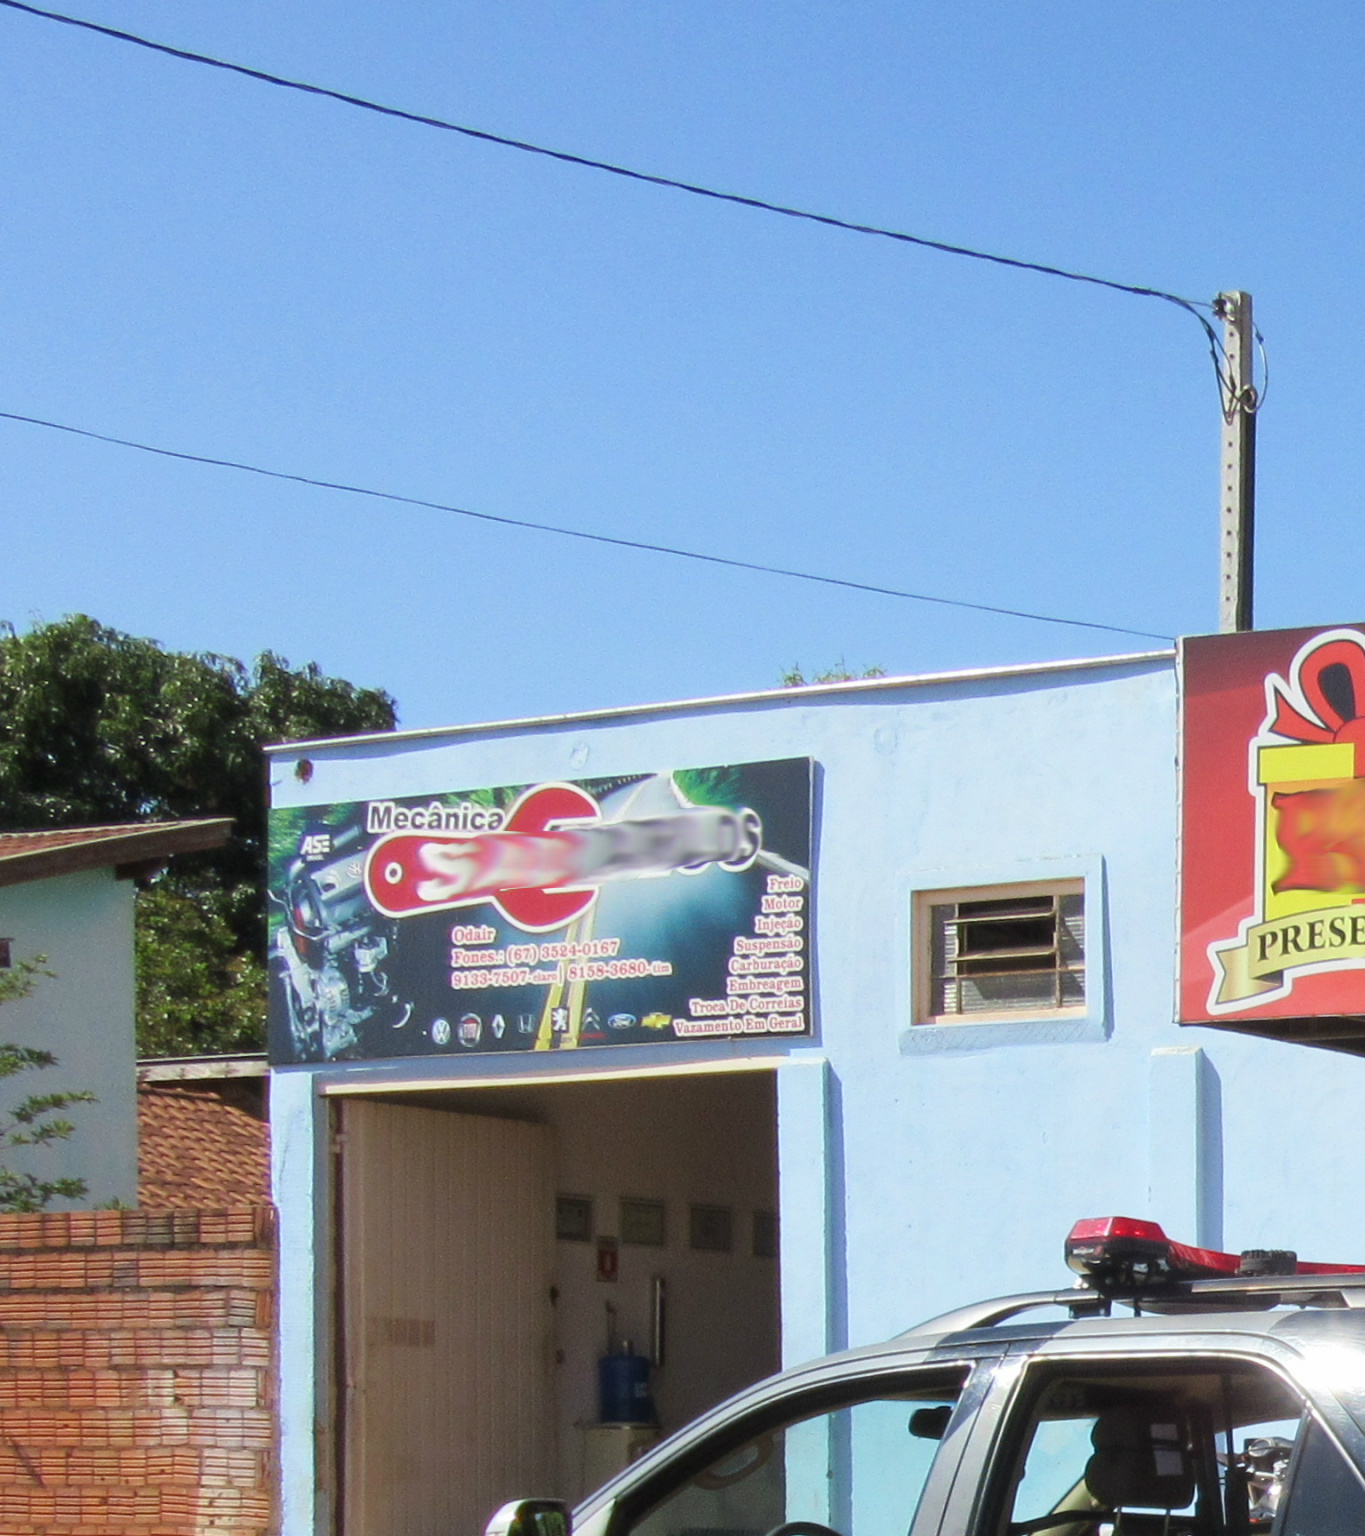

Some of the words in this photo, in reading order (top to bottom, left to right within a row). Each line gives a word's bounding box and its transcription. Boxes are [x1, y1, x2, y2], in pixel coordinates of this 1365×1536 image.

[368, 803, 505, 831] Mecânica
[768, 875, 802, 891] Freio
[764, 896, 802, 911] Motor
[757, 915, 802, 934] Injeção
[453, 926, 495, 943] Odair
[506, 946, 539, 964] (67)
[542, 941, 618, 959] 3524-0167
[736, 935, 802, 955] Suspensão
[731, 955, 802, 974] Carburação
[729, 977, 801, 994] Embreagem
[692, 1000, 726, 1015] Troca
[730, 1000, 746, 1013] De
[750, 996, 802, 1012] Correias
[675, 1019, 742, 1034] Vazamento
[746, 1017, 765, 1031] Em
[769, 1015, 802, 1030] Geral
